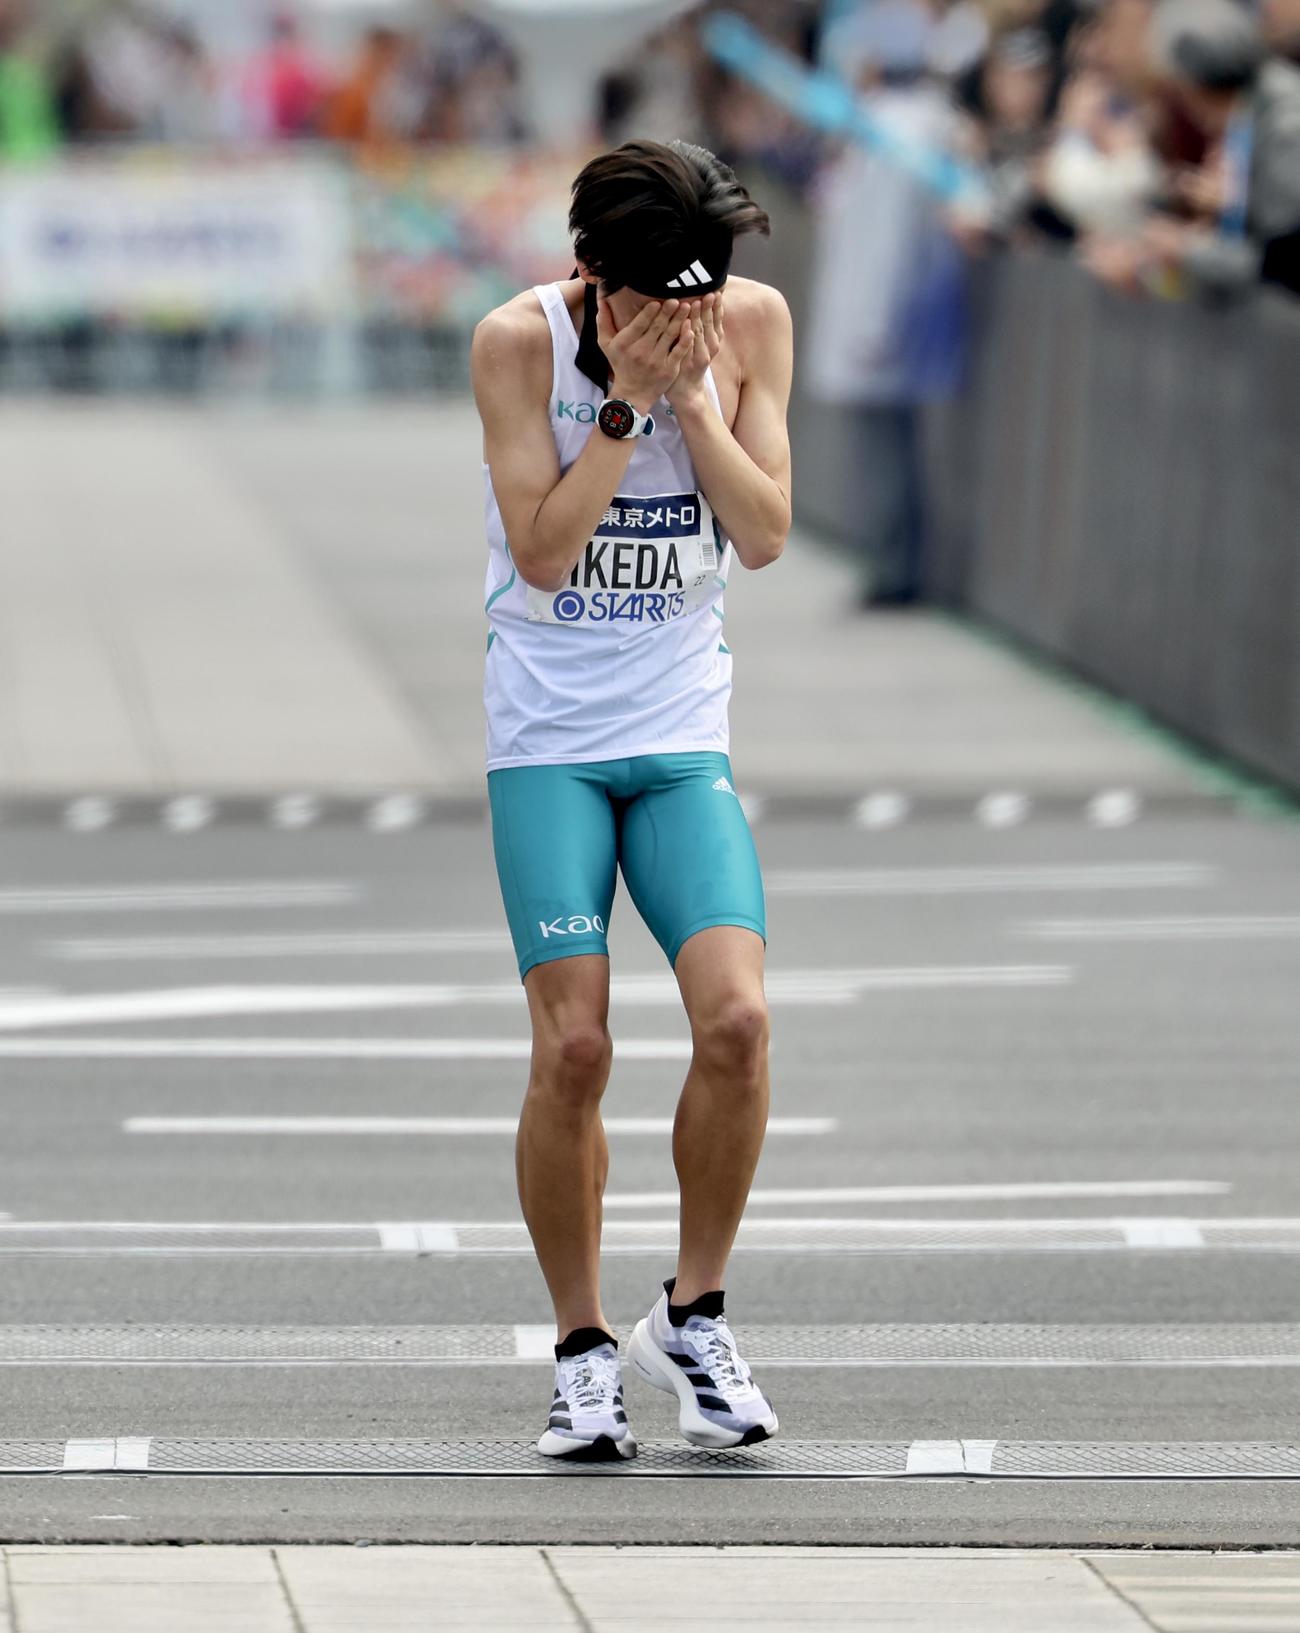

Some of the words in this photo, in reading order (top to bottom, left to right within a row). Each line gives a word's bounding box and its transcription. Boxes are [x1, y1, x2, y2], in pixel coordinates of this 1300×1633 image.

[557, 400, 597, 423] Ka
[600, 506, 695, 529] 東京メトロ
